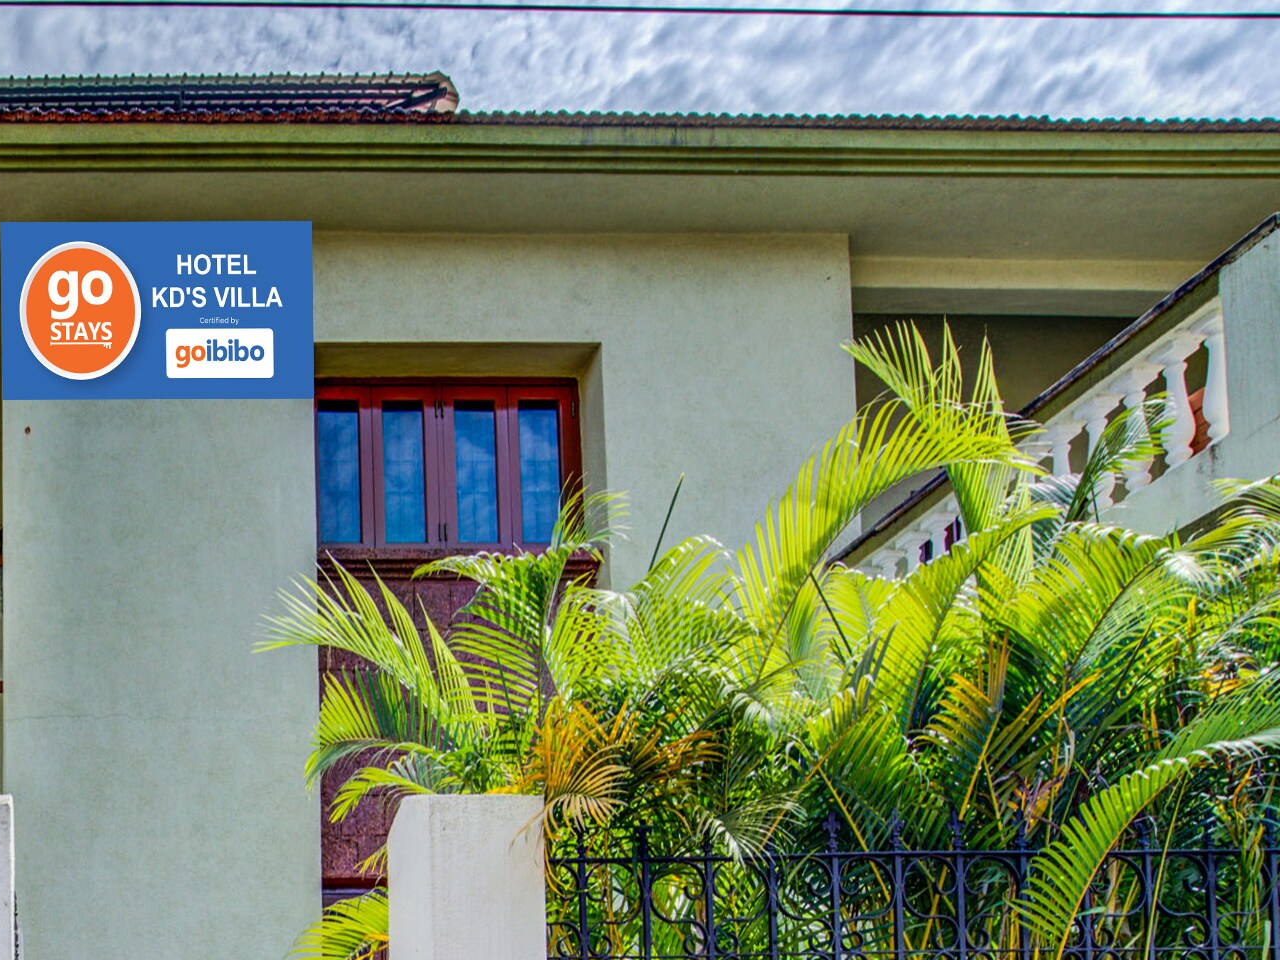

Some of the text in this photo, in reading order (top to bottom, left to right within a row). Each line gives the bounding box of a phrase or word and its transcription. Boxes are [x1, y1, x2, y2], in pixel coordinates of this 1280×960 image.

[176, 254, 257, 275] HOTEL
[47, 269, 113, 320] go
[151, 286, 283, 308] KD'S VILLA
[50, 321, 113, 341] STAYS
[199, 316, 240, 325] Certified by
[175, 339, 265, 368] goibibo
